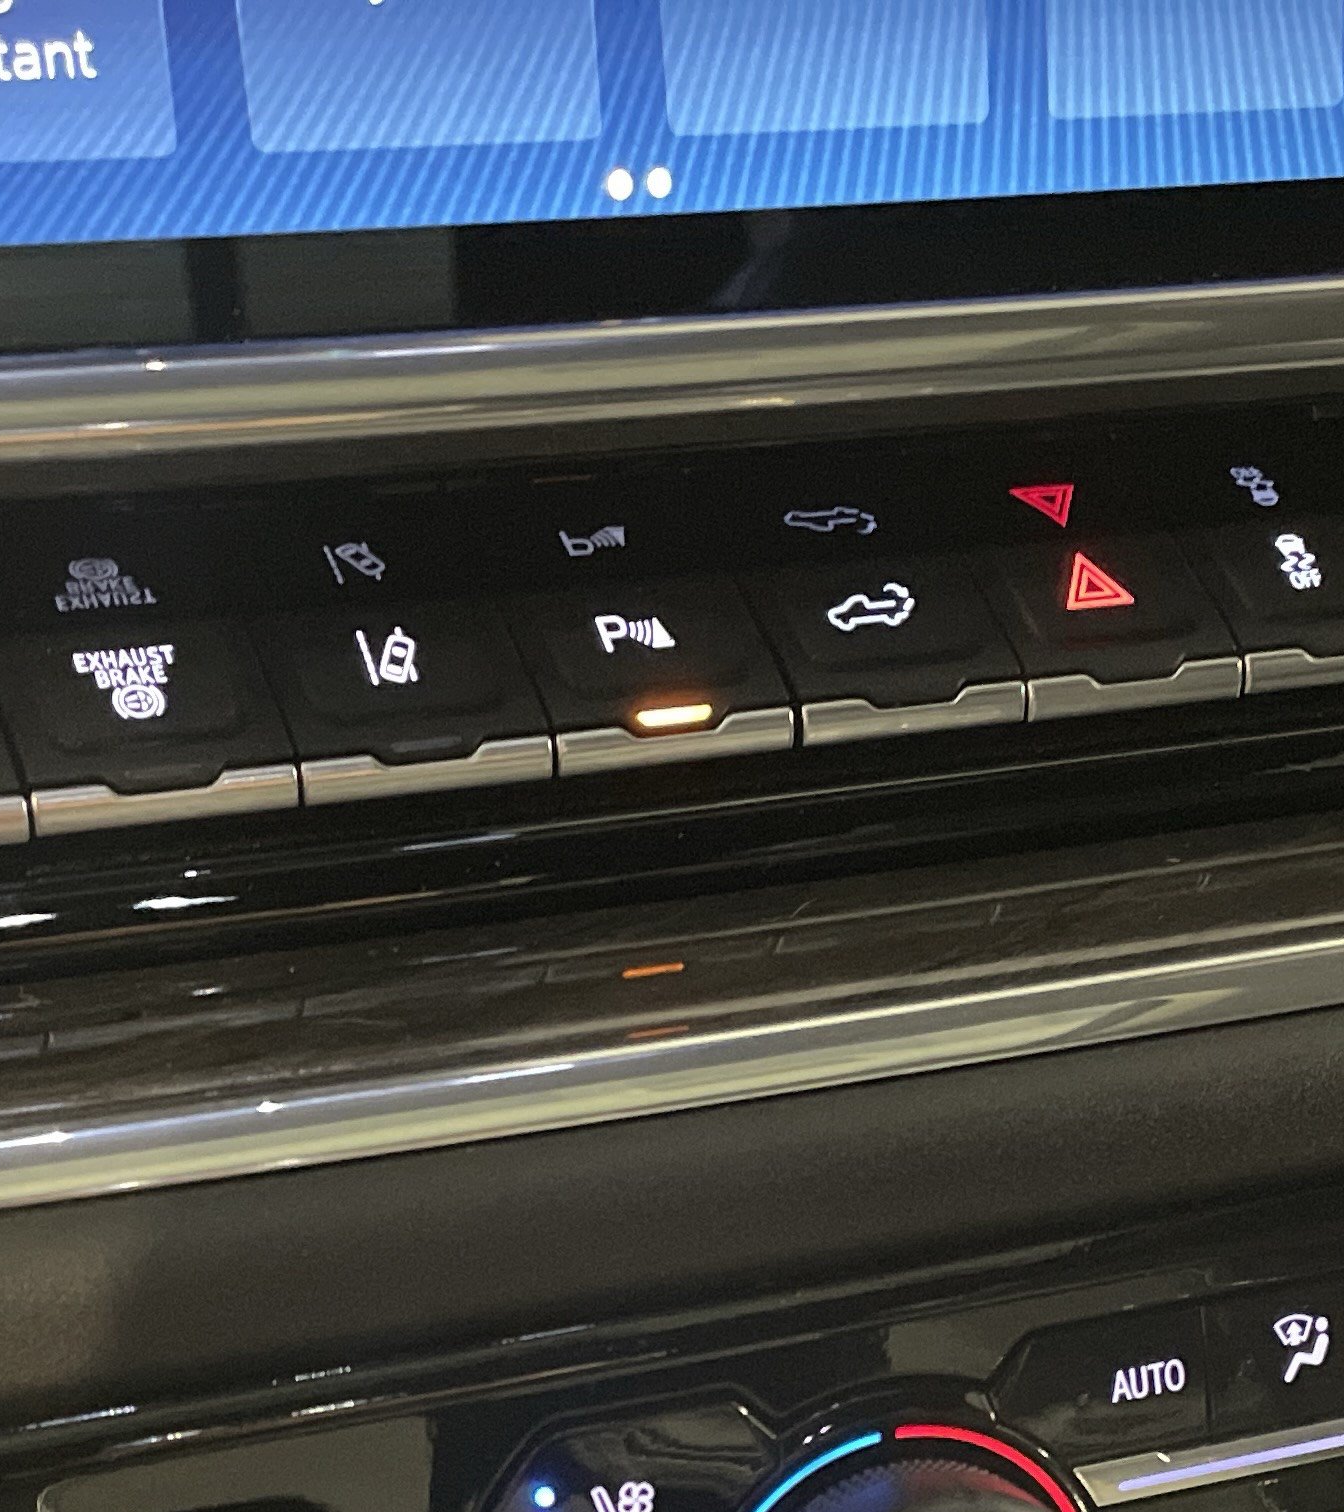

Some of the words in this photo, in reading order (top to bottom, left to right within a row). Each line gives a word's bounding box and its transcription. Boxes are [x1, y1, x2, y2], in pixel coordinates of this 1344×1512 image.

[71, 643, 175, 674] EXHAUST
[93, 662, 169, 690] BRAKE
[1111, 1357, 1187, 1404] AUTO
